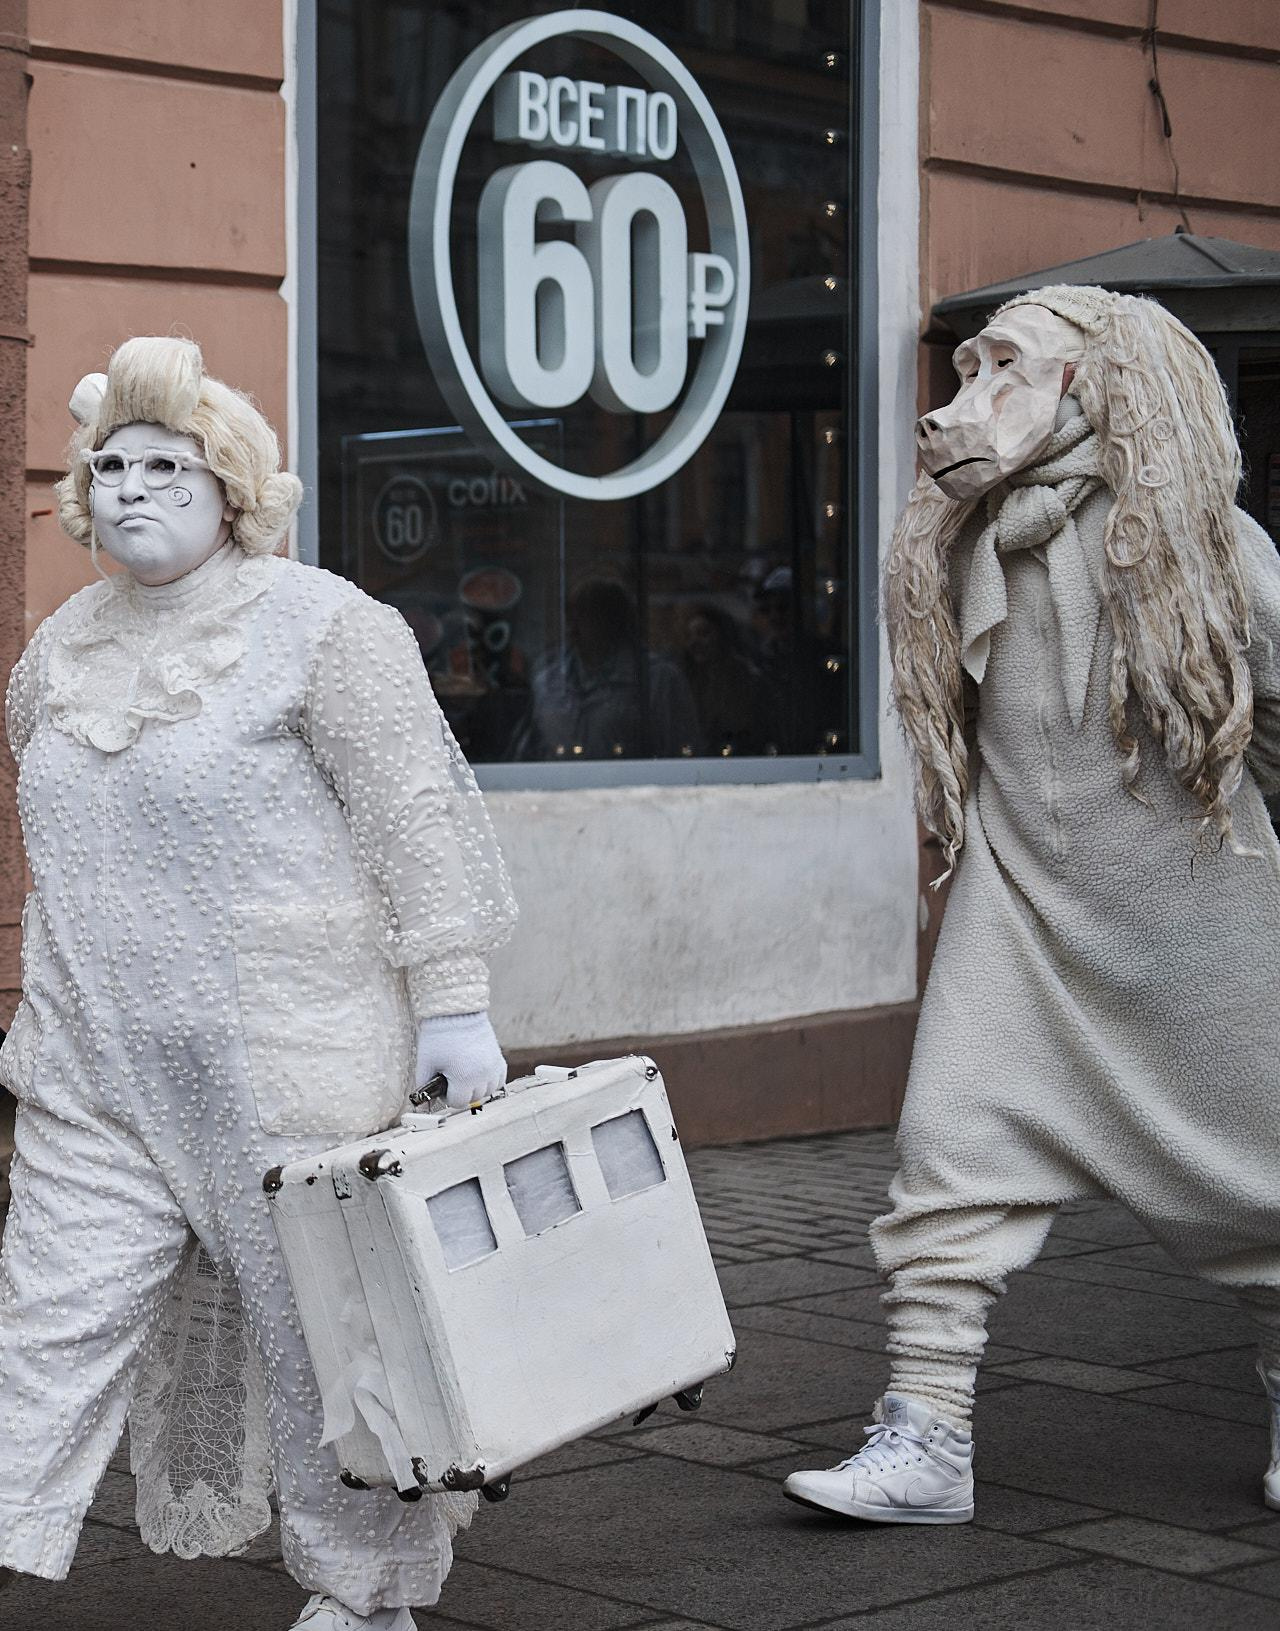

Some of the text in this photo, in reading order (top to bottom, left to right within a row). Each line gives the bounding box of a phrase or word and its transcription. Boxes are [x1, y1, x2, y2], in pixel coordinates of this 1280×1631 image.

[517, 70, 678, 161] ВСЕ ПО
[386, 504, 423, 547] 60
